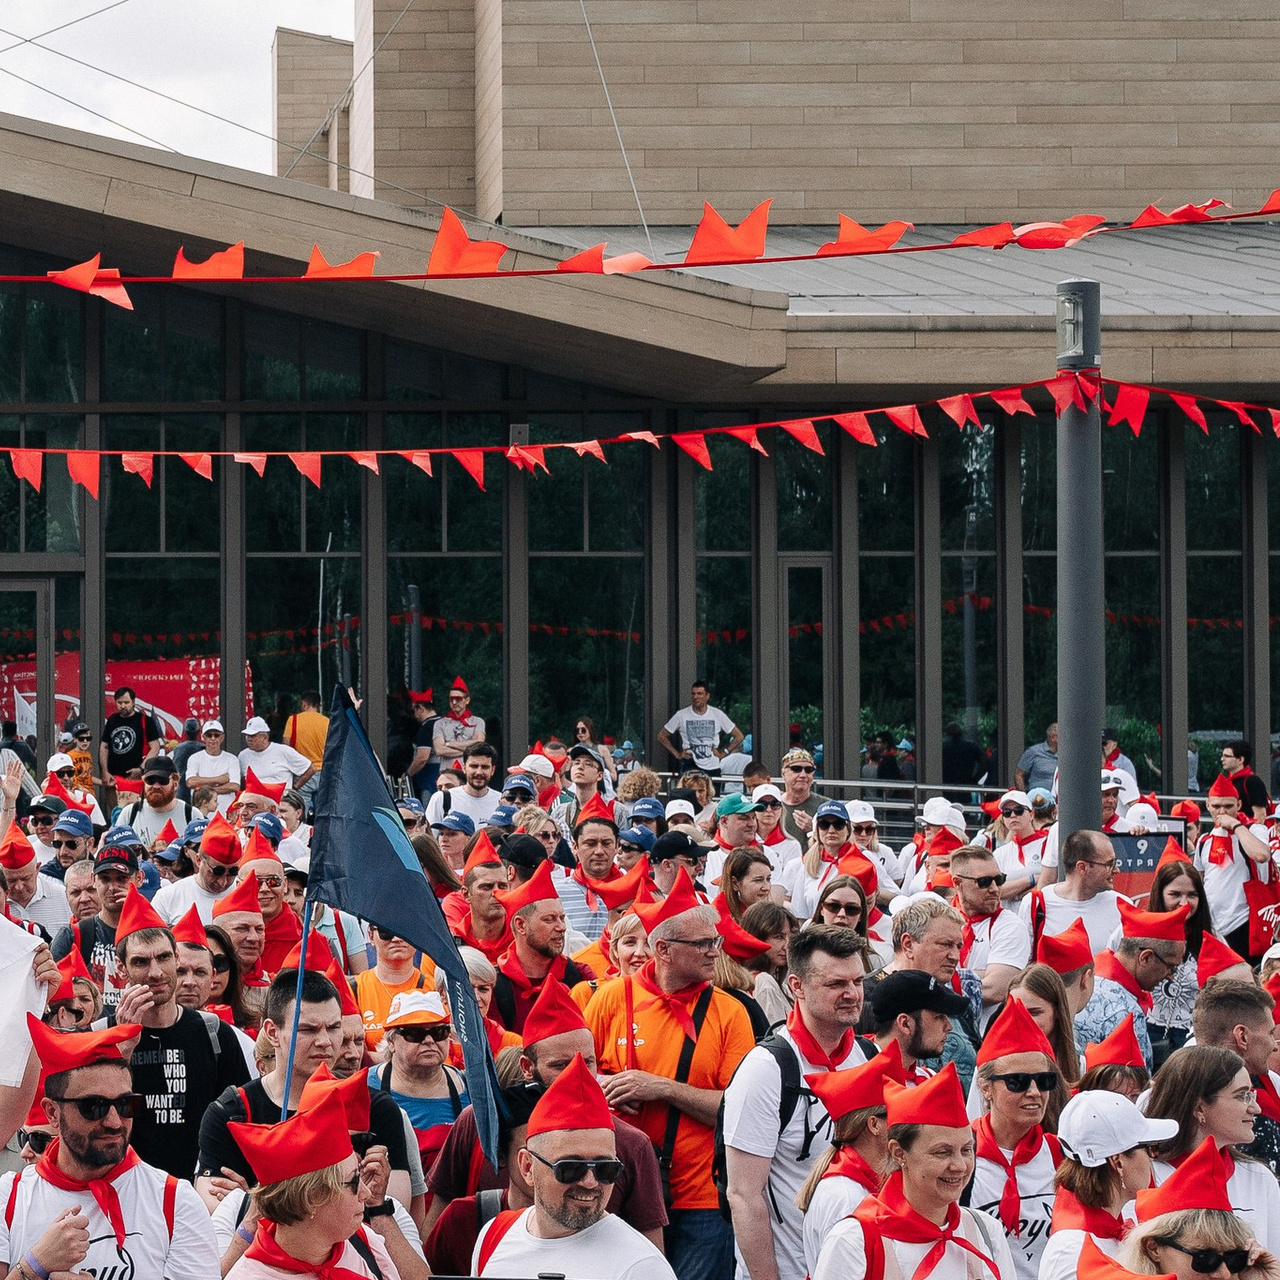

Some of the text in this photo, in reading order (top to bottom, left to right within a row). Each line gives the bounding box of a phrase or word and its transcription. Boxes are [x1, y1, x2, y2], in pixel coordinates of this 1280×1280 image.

[1136, 839, 1149, 855] 9
[1115, 859, 1154, 867] ОТРЯ
[131, 1049, 185, 1066] REMEMBER
[163, 1064, 186, 1079] WHO
[166, 1078, 187, 1094] YOU
[145, 1094, 186, 1110] WANTED
[155, 1109, 185, 1124] TO BE.
